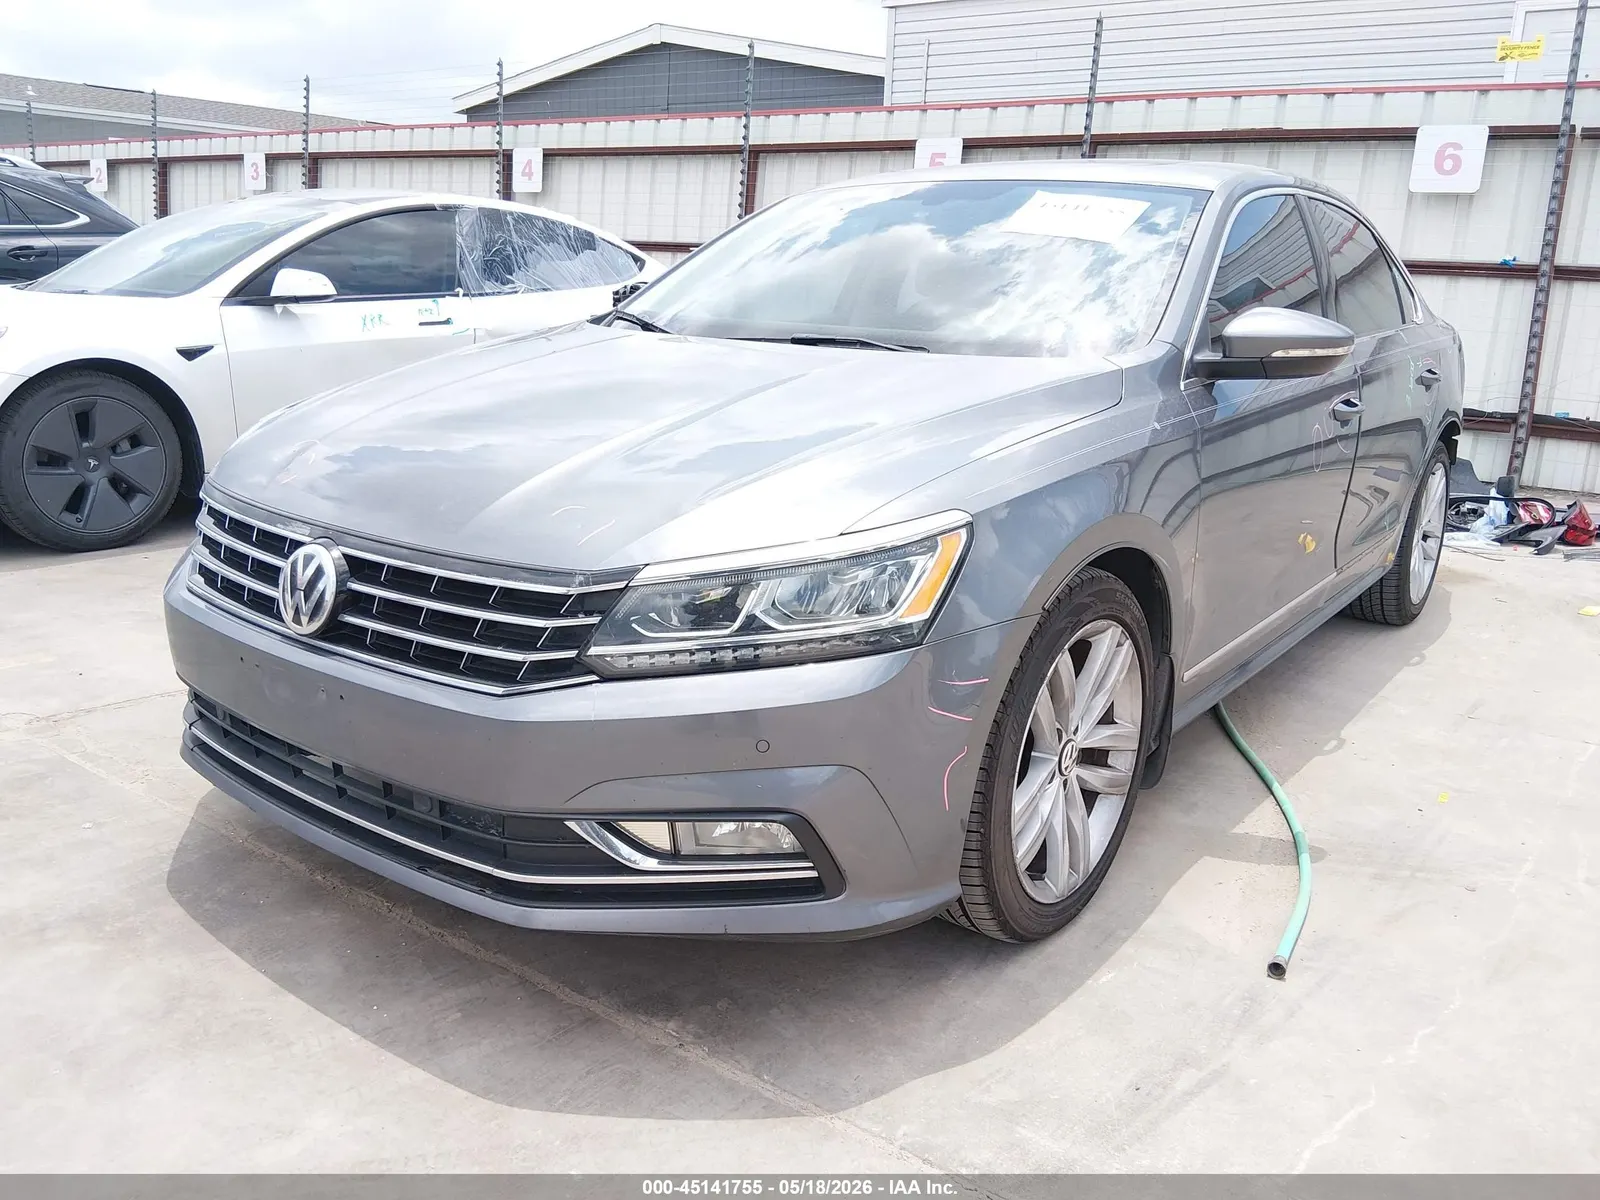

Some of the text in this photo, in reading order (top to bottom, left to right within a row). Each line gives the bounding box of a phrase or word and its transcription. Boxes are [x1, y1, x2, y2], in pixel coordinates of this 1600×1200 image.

[521, 159, 534, 181] 4
[1434, 142, 1463, 176] 6
[95, 167, 103, 184] 2
[251, 162, 260, 181] 3
[281, 549, 331, 630] VW
